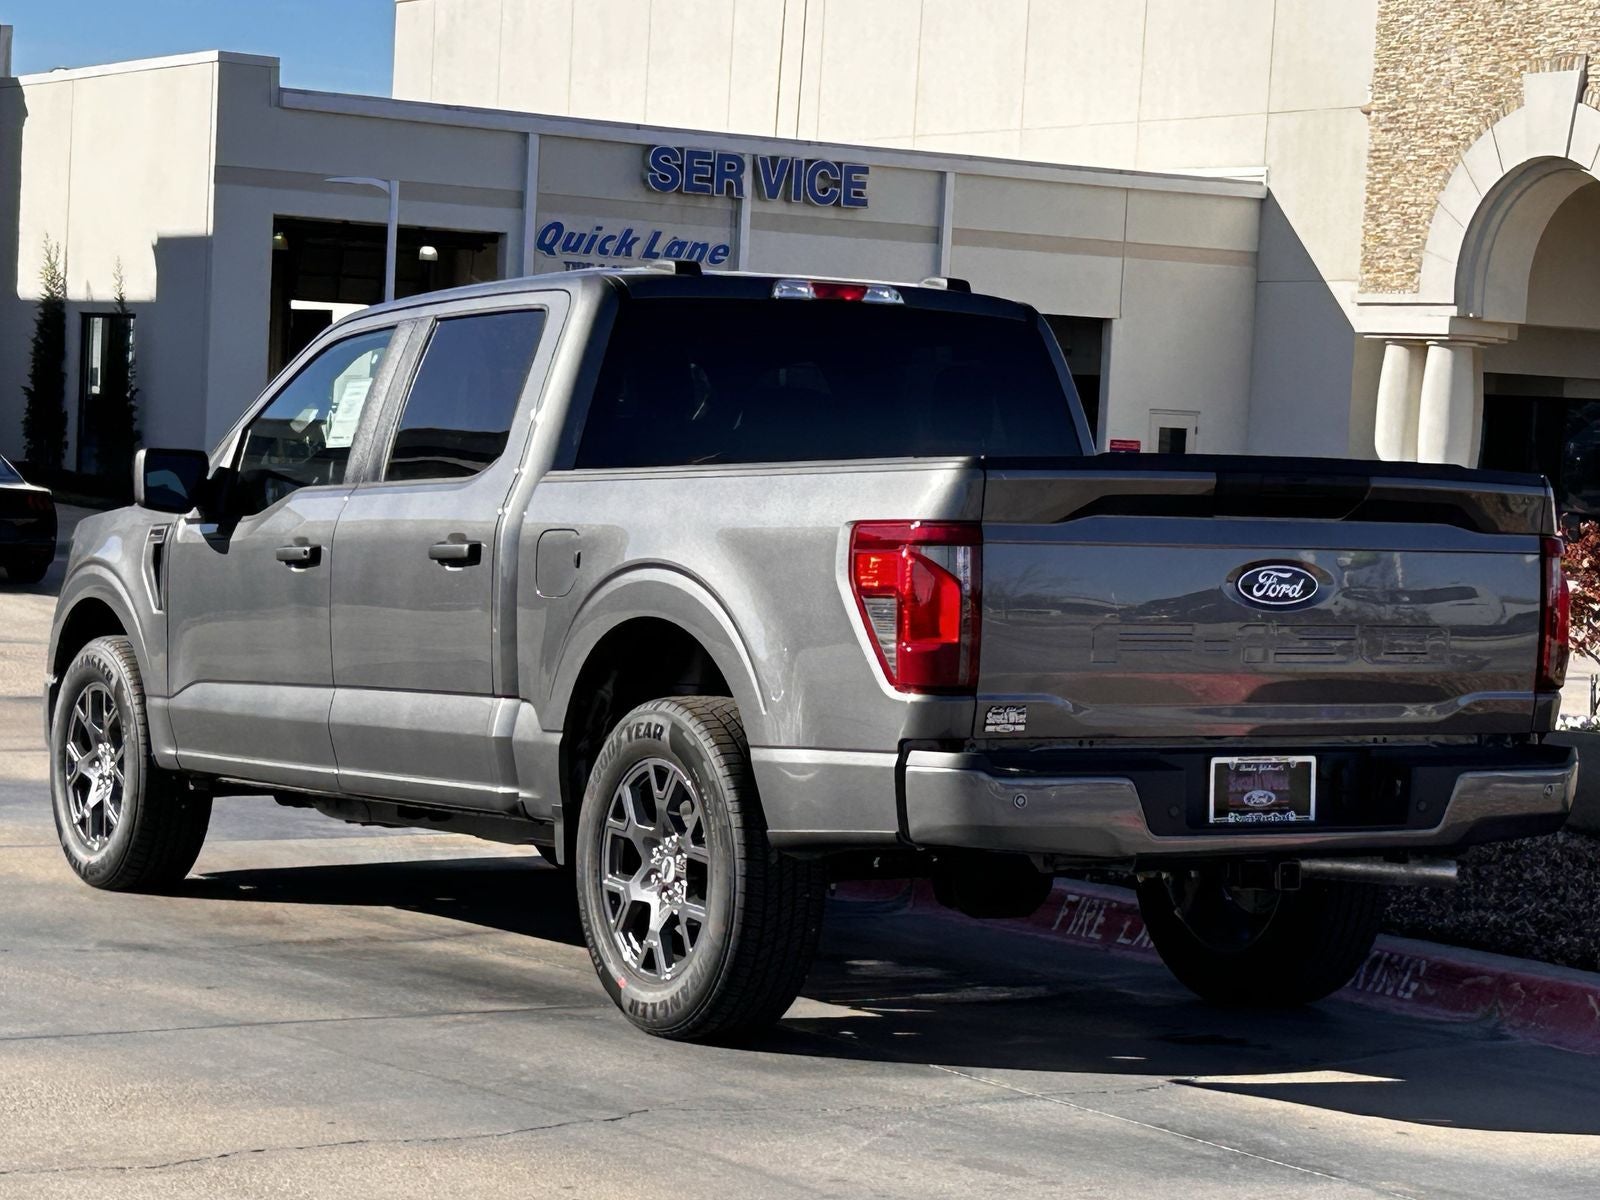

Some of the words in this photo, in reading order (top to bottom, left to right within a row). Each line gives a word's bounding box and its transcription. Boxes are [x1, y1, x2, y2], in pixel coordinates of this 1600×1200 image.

[536, 221, 640, 258] Quick
[640, 230, 731, 266] Lane
[1252, 569, 1305, 599] Ford
[1051, 894, 1110, 940] FIRE
